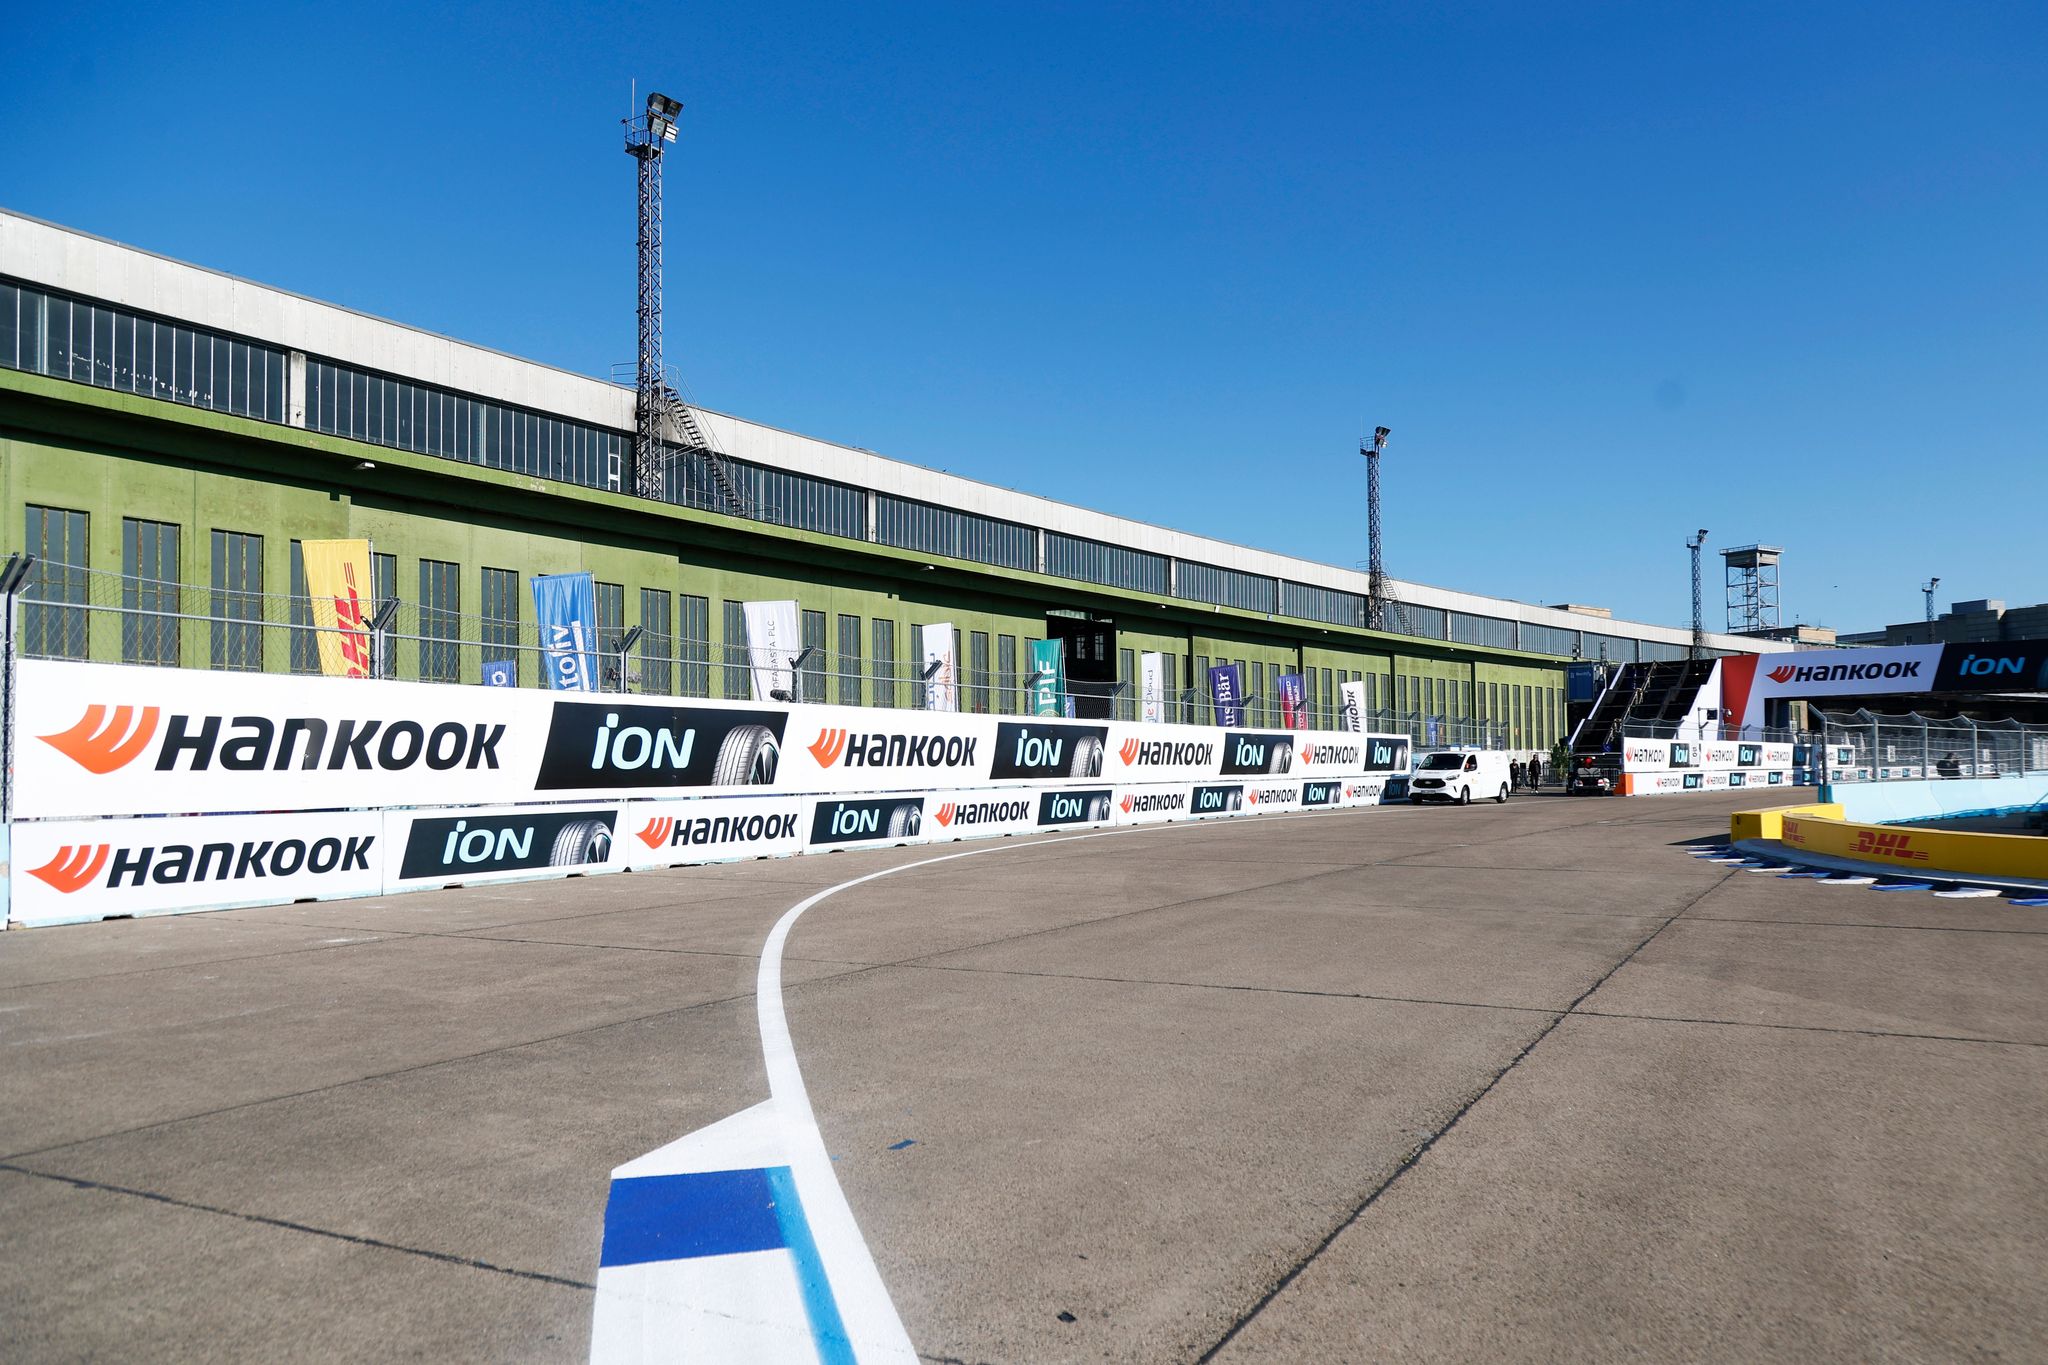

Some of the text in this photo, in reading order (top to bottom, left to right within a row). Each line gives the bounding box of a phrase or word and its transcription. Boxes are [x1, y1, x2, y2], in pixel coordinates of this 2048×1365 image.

[768, 620, 776, 637] PLC
[549, 625, 580, 690] toliv
[1039, 660, 1056, 705] PIF
[1146, 669, 1154, 705] Cloud
[1217, 673, 1232, 702] Bär
[1858, 831, 1914, 858] DHL
